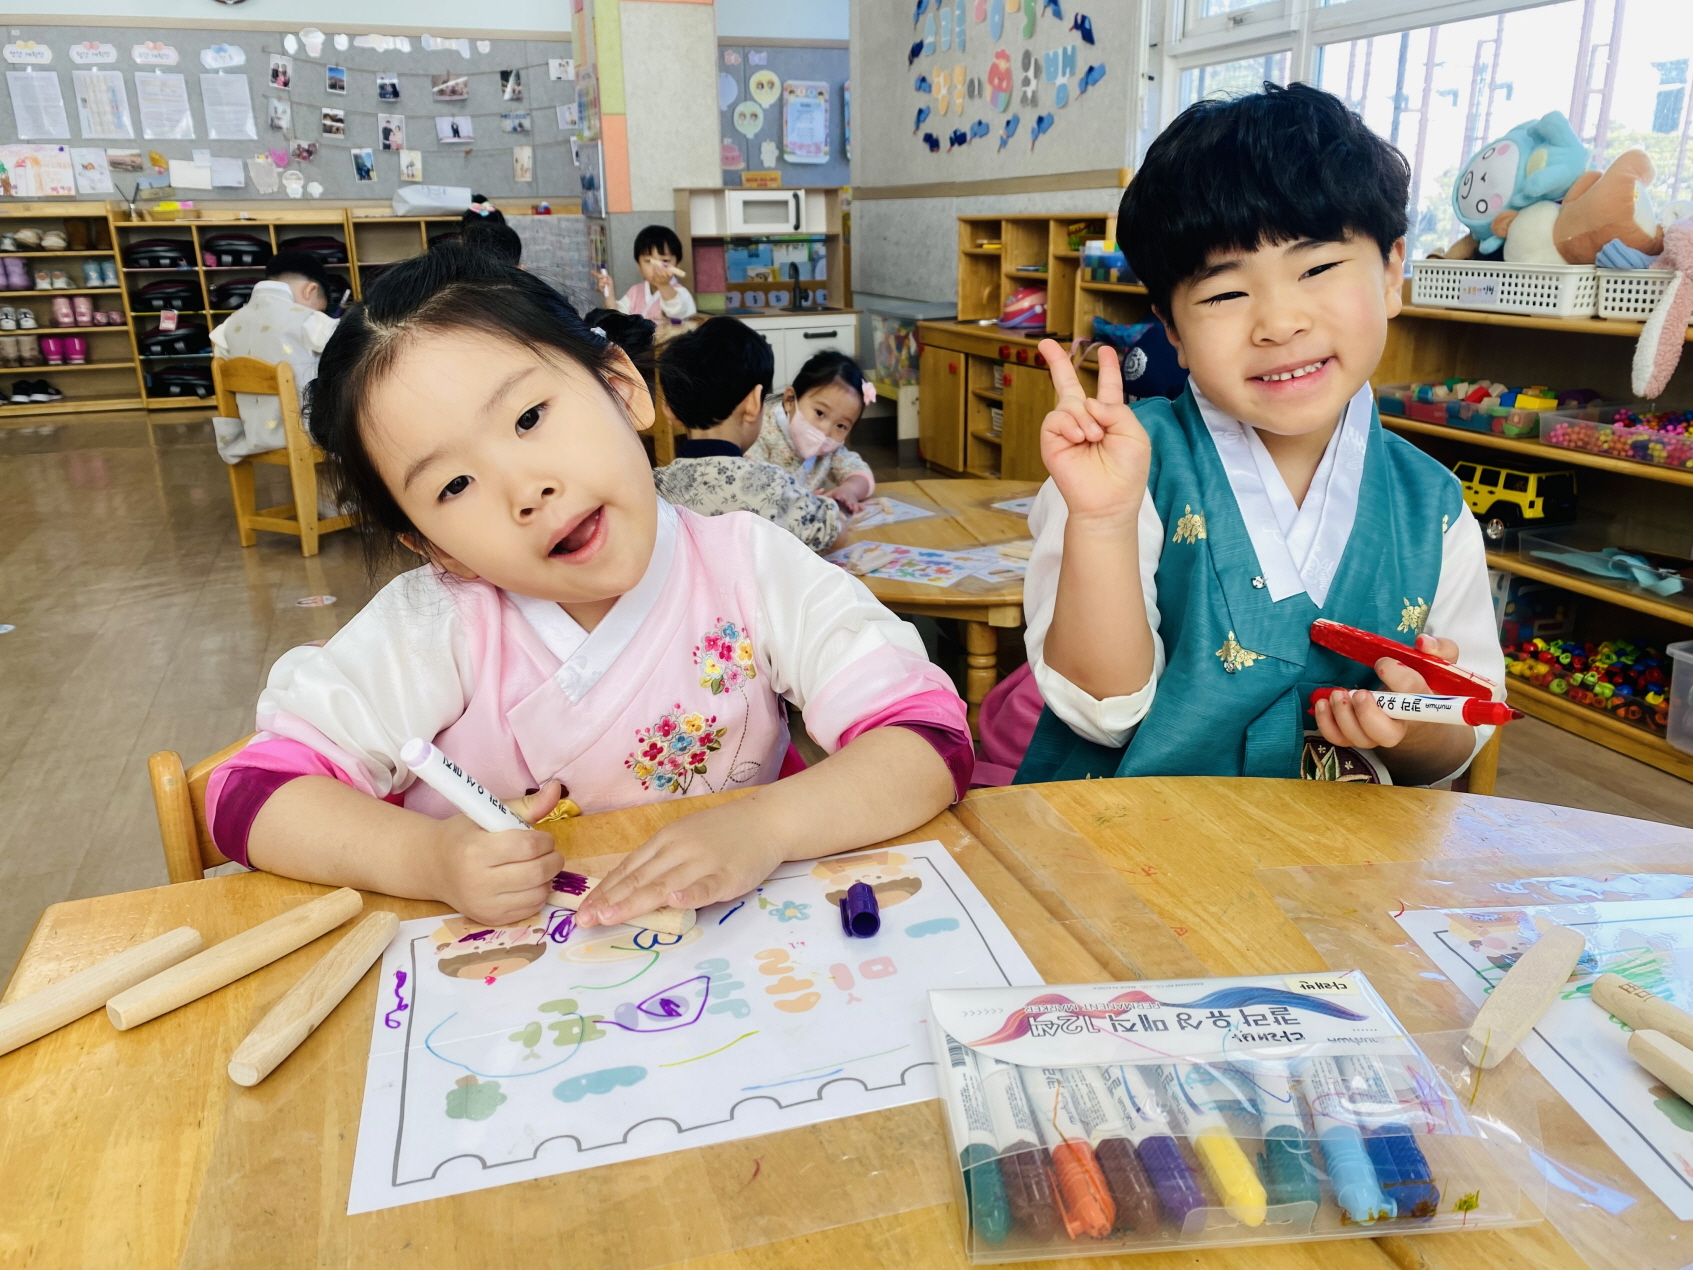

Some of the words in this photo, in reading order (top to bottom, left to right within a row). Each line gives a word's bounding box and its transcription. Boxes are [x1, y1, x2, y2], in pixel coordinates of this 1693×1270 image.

[1400, 697, 1422, 713] 칼라
[1425, 702, 1452, 712] munhwa
[1299, 980, 1348, 990] 다래반
[1023, 1003, 1079, 1013] MARKER
[1081, 1001, 1161, 1012] PERMANENT
[1027, 1015, 1101, 1038] 12색
[1232, 1030, 1306, 1043] 다래반
